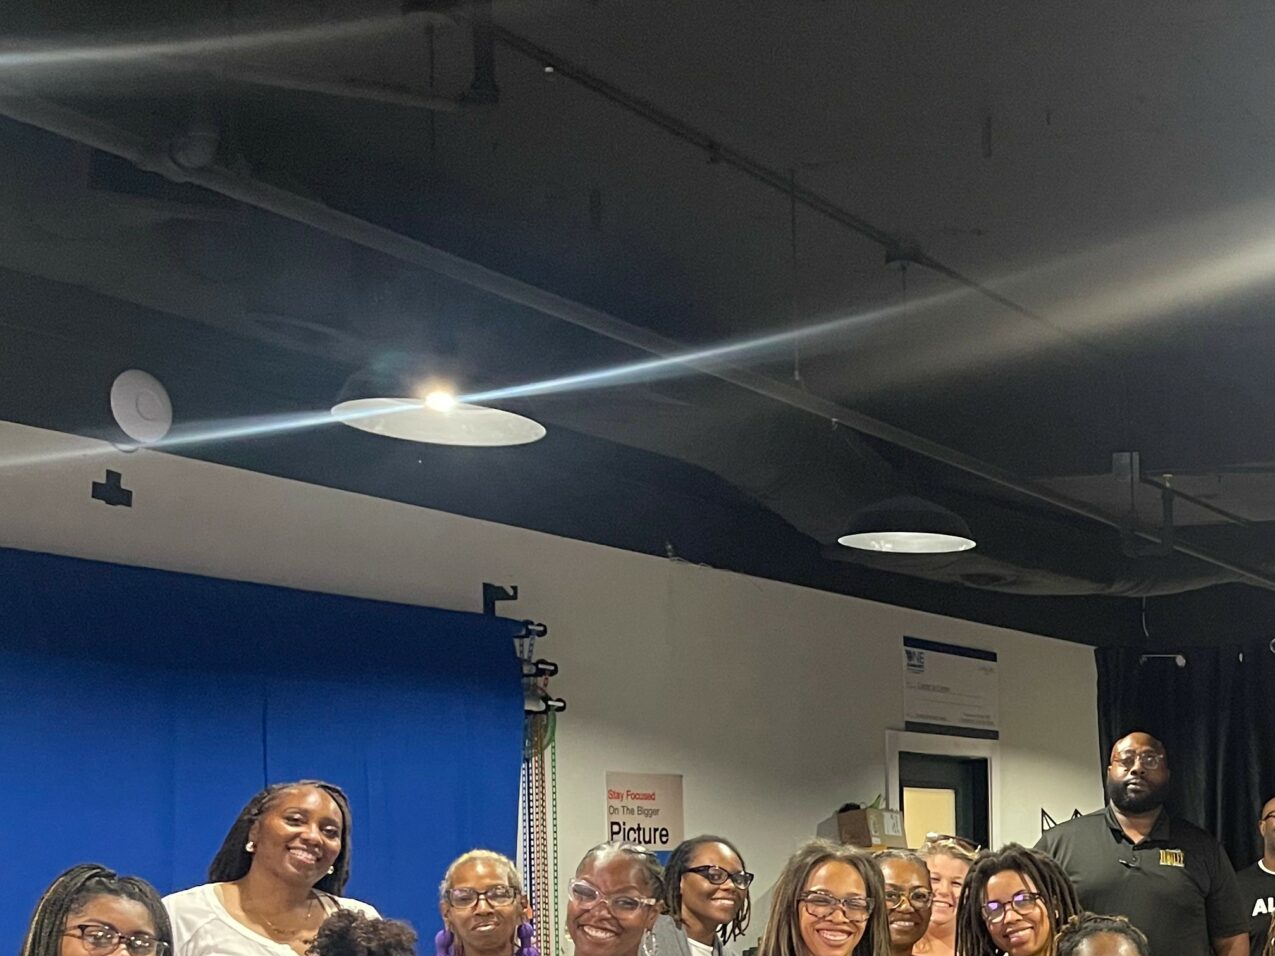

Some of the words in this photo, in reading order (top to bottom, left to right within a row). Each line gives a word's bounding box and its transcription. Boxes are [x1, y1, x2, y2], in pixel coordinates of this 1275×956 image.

[608, 789, 624, 802] Stay
[626, 790, 656, 801] Focused
[608, 805, 619, 816] On
[621, 805, 635, 816] The
[637, 806, 660, 818] Bigger
[610, 821, 669, 845] Picture
